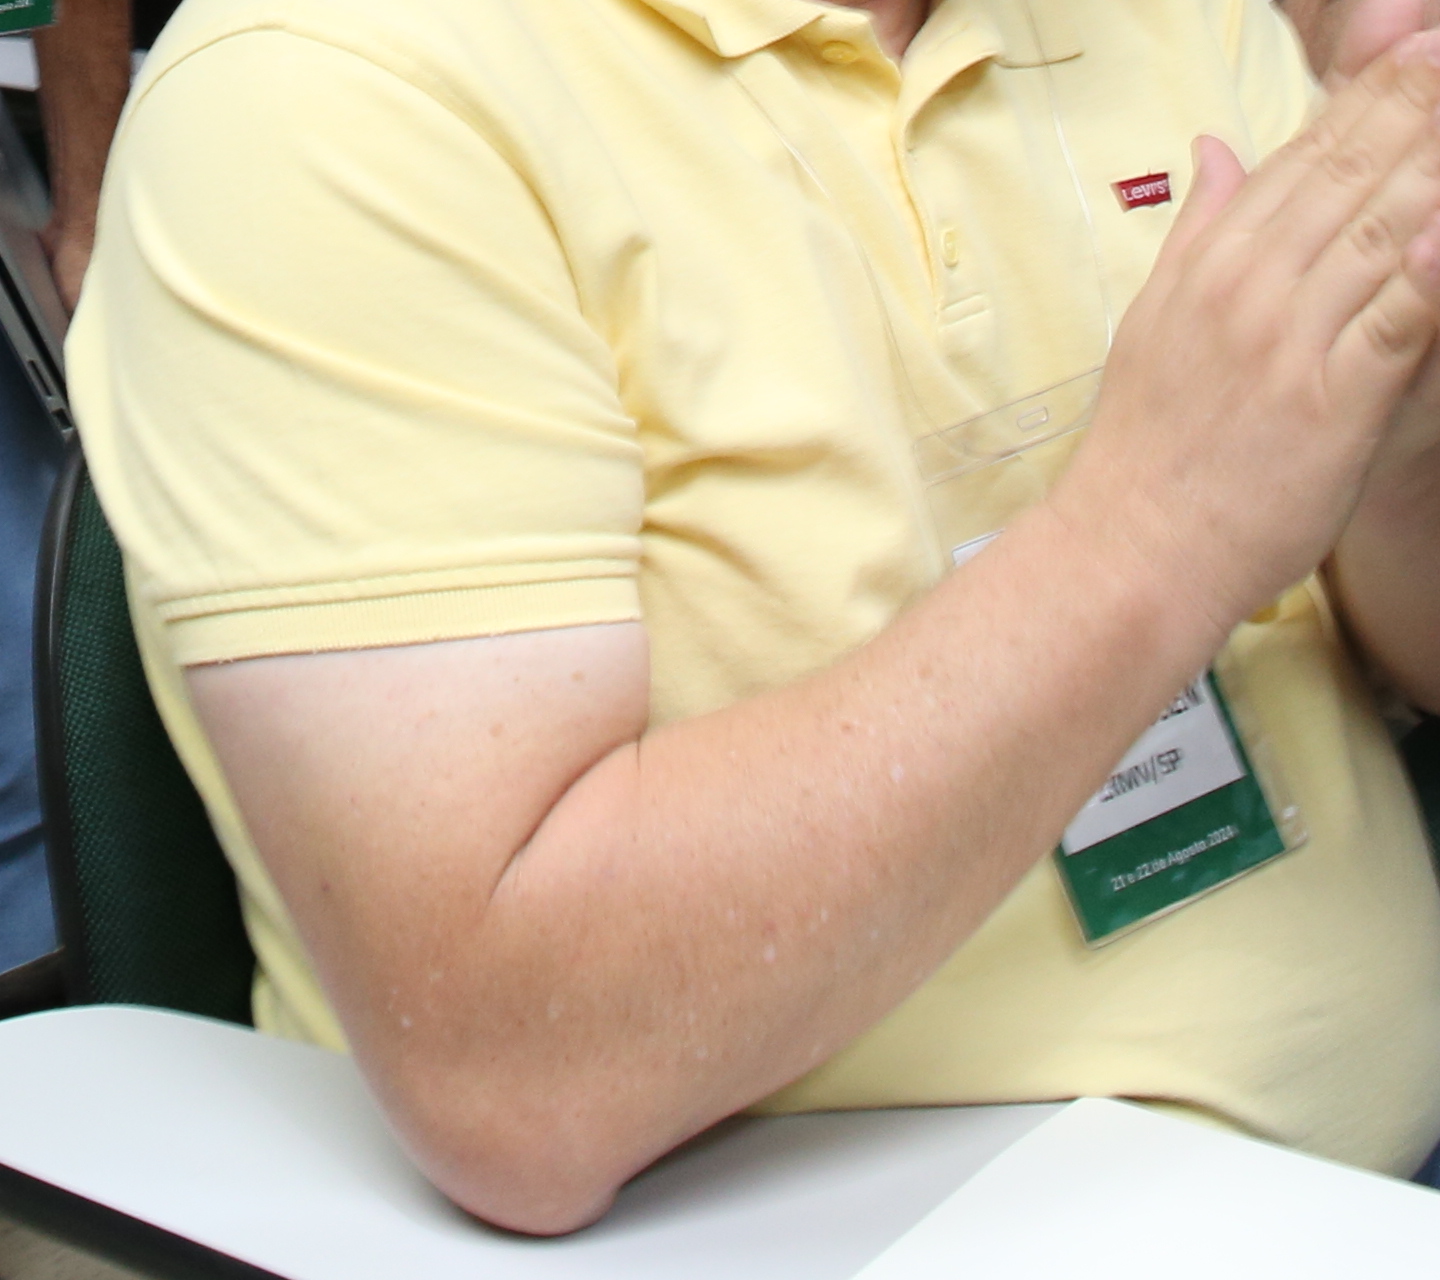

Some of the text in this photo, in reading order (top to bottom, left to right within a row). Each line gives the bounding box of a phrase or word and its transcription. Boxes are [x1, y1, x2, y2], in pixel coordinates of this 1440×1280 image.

[1111, 875, 1126, 891] 21
[1136, 863, 1152, 880] 22
[1167, 840, 1208, 865] Agosto
[1206, 825, 1236, 846] 2024
